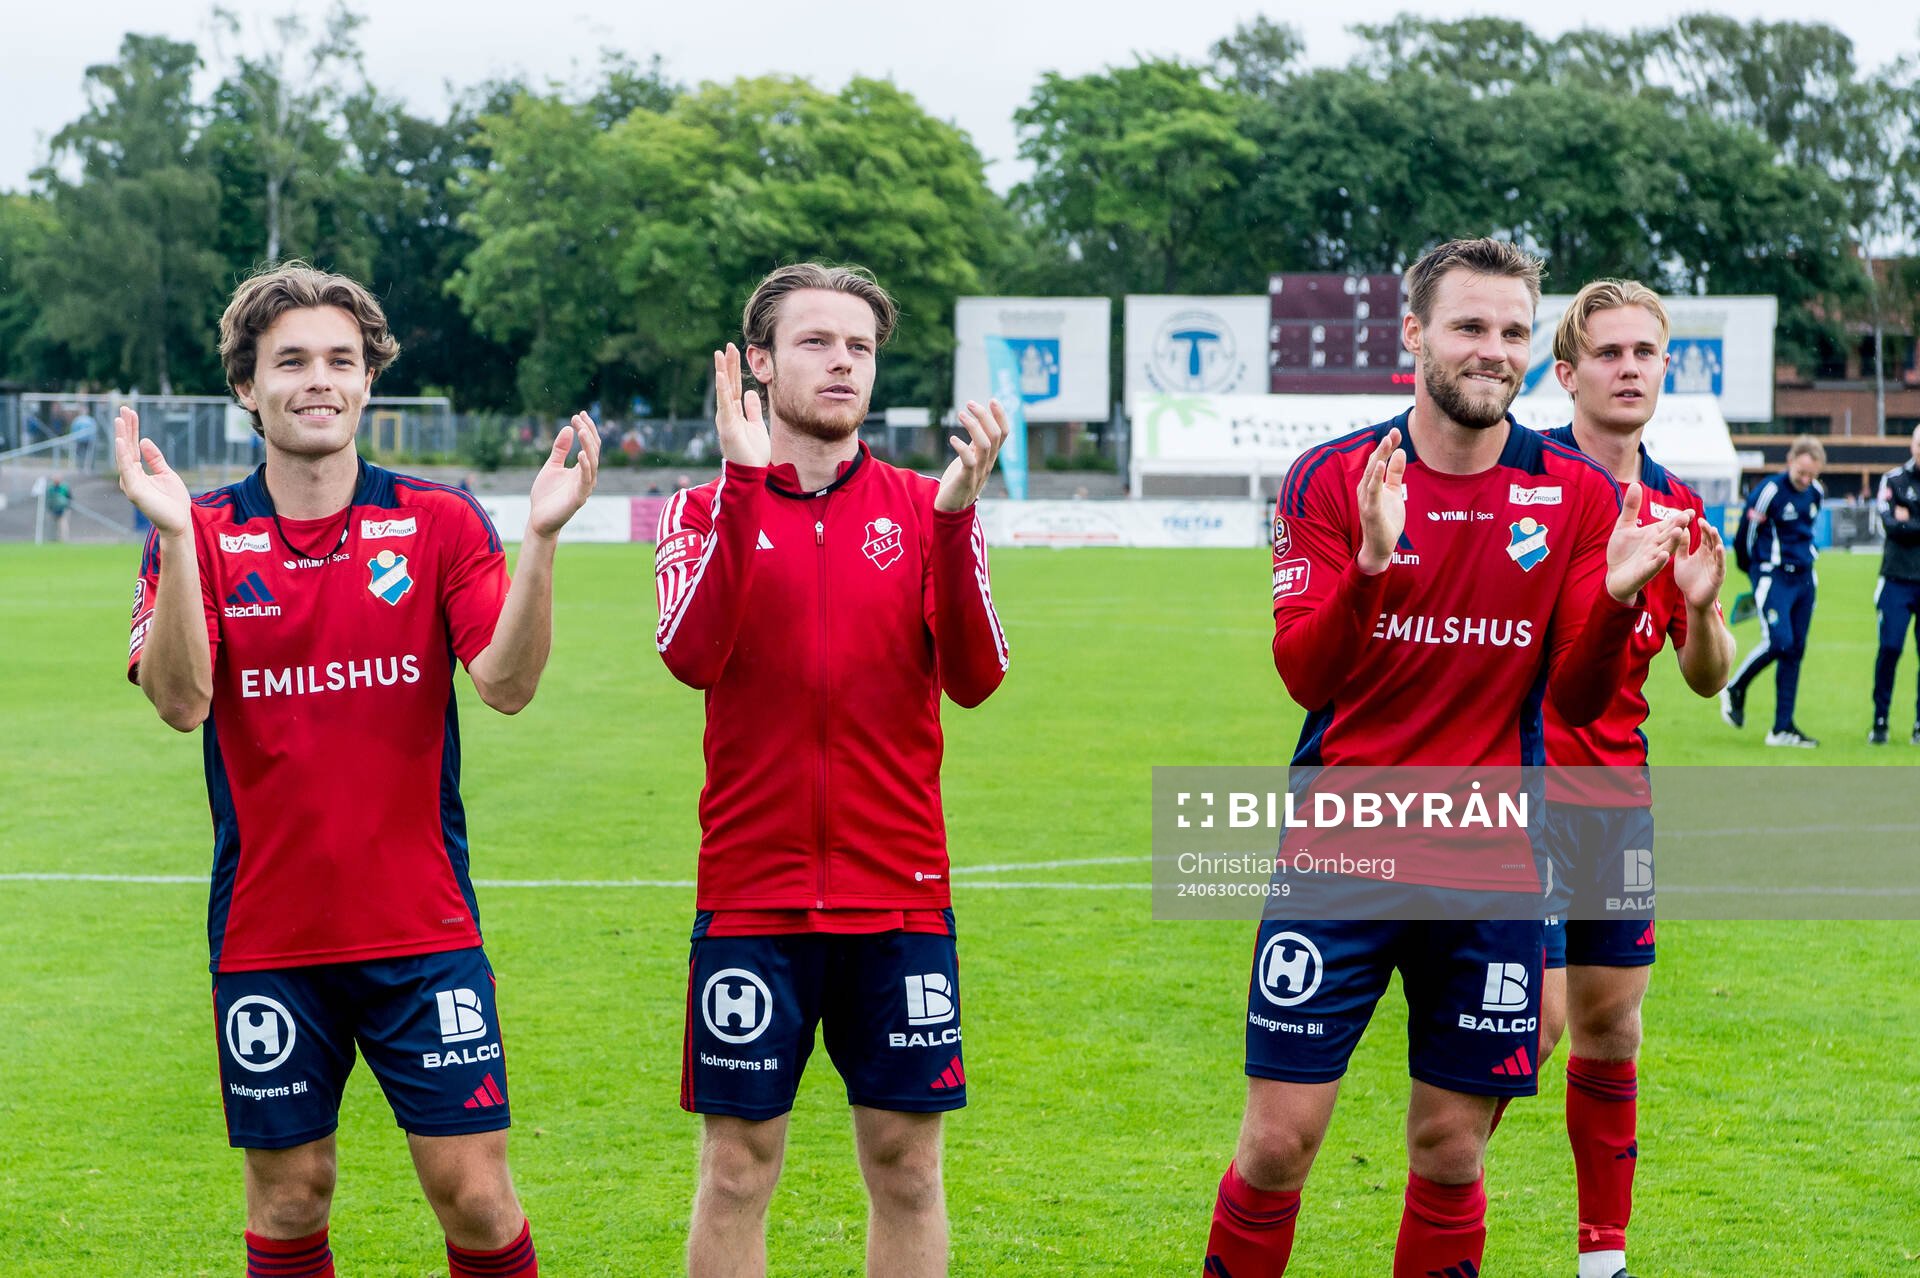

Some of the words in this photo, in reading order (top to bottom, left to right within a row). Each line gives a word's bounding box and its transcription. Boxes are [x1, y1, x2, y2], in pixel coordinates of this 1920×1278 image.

[1477, 511, 1494, 521] Spcs
[332, 553, 350, 563] Spcs
[656, 534, 697, 565] NIBET
[1273, 566, 1305, 587] IBET
[224, 604, 281, 618] stadium
[1373, 613, 1533, 647] EMILSHUS
[242, 655, 421, 698] EMILSHUS
[1606, 895, 1656, 910] BALC
[1249, 1012, 1304, 1034] Holmgrens
[1307, 1022, 1324, 1036] Bil
[1458, 1014, 1537, 1033] BALCO
[423, 1042, 500, 1069] BALCO
[700, 1052, 761, 1071] Holmgrens
[764, 1058, 778, 1071] Bil
[230, 1082, 289, 1101] Holmgrens
[292, 1080, 308, 1096] Bil
